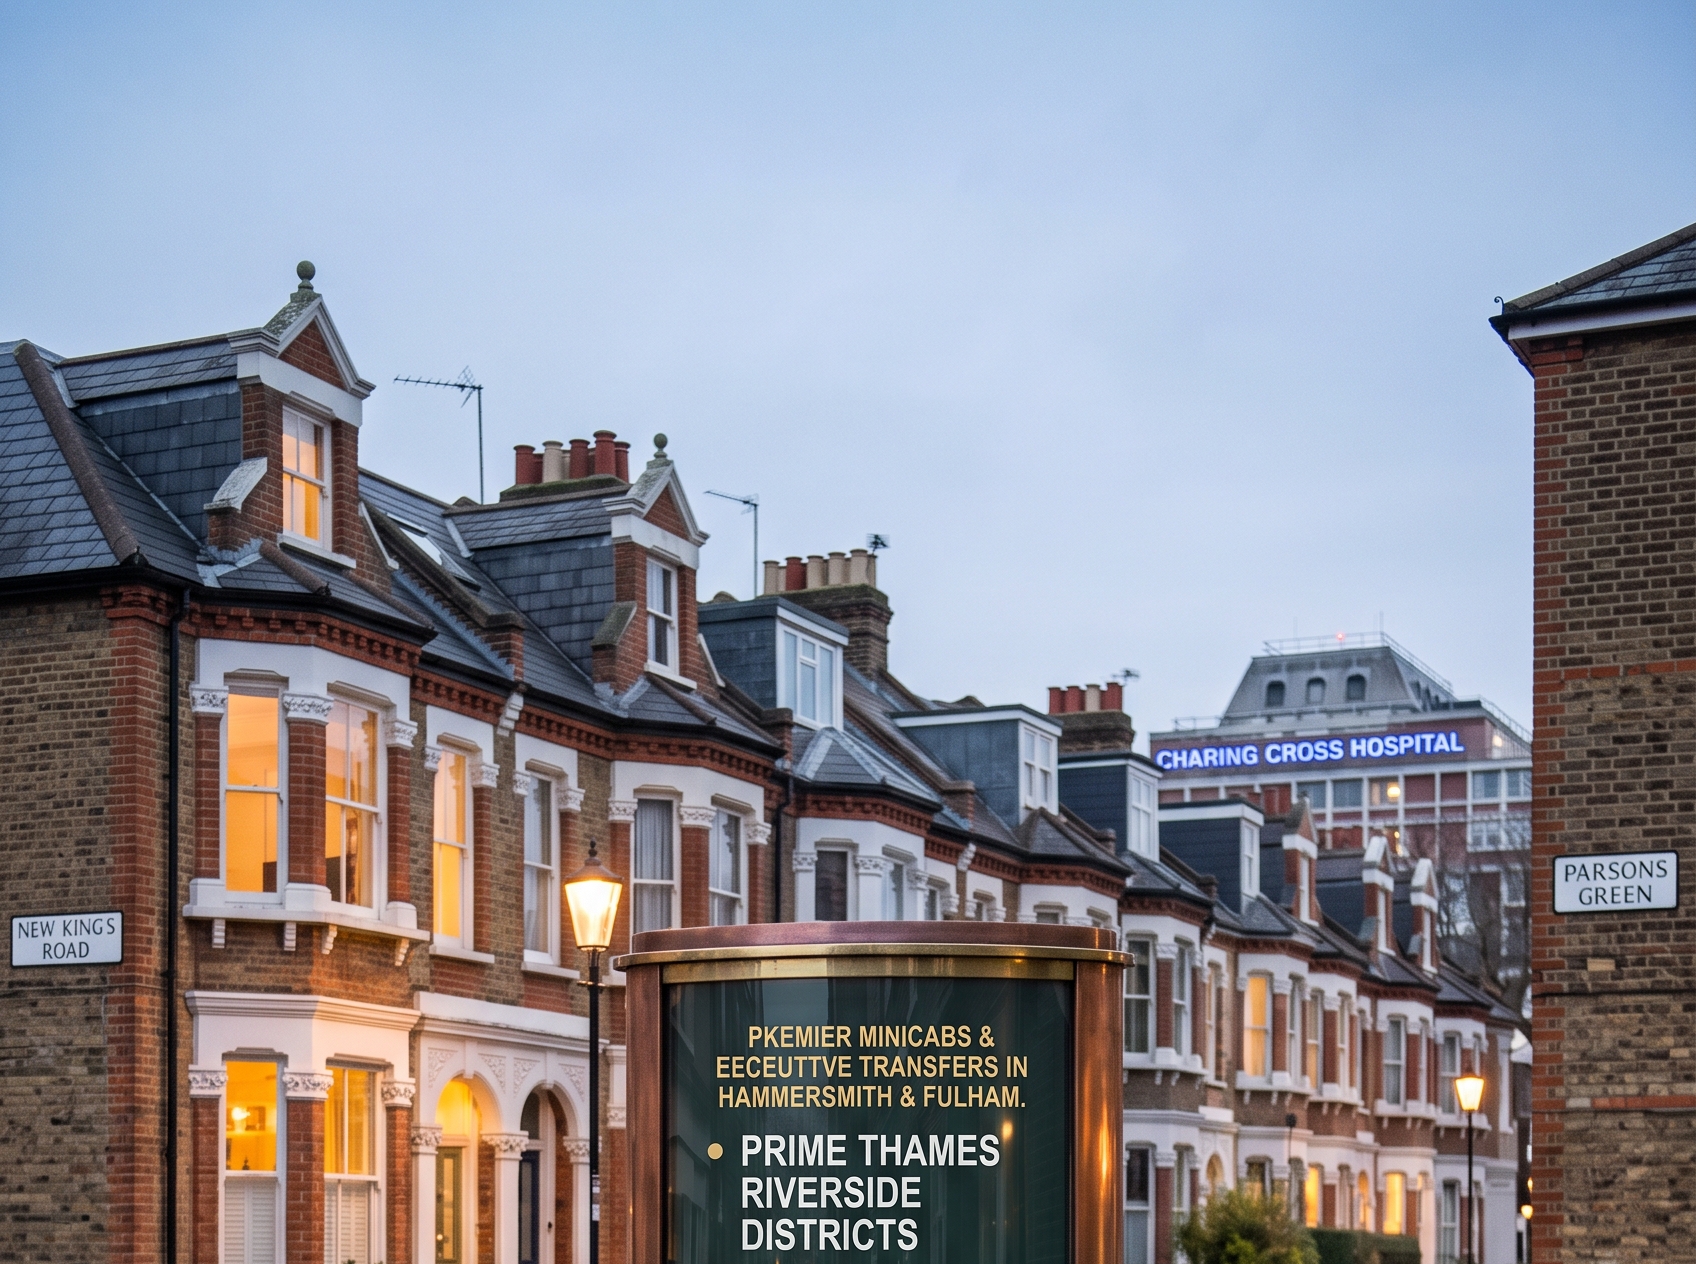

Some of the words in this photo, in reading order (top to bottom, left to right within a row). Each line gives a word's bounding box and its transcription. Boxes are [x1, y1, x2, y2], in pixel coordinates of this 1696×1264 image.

[1156, 745, 1258, 770] CHARING
[1265, 740, 1345, 764] CROSS
[1350, 732, 1464, 758] HOSPITAL
[1564, 860, 1667, 882] PARSONS
[1579, 885, 1652, 905] GREEN
[18, 920, 55, 938] NEW
[63, 918, 115, 936] KINGS
[43, 942, 89, 959] ROAD
[749, 1025, 851, 1047] PKEMIER
[859, 1025, 972, 1047] MINICABS
[979, 1025, 995, 1047] &
[716, 1056, 852, 1078] EECEUTTVE
[859, 1056, 999, 1077] TRANSFERS
[1006, 1056, 1028, 1077] IN
[719, 1086, 892, 1107] HAMMERSMITH
[900, 1085, 916, 1107] &
[923, 1085, 1026, 1107] FULHAM.
[741, 1134, 847, 1166] PRIME
[858, 1134, 1000, 1166] THAMES
[741, 1176, 921, 1208] RIVERSIDE
[741, 1218, 918, 1251] DISTRICTS
